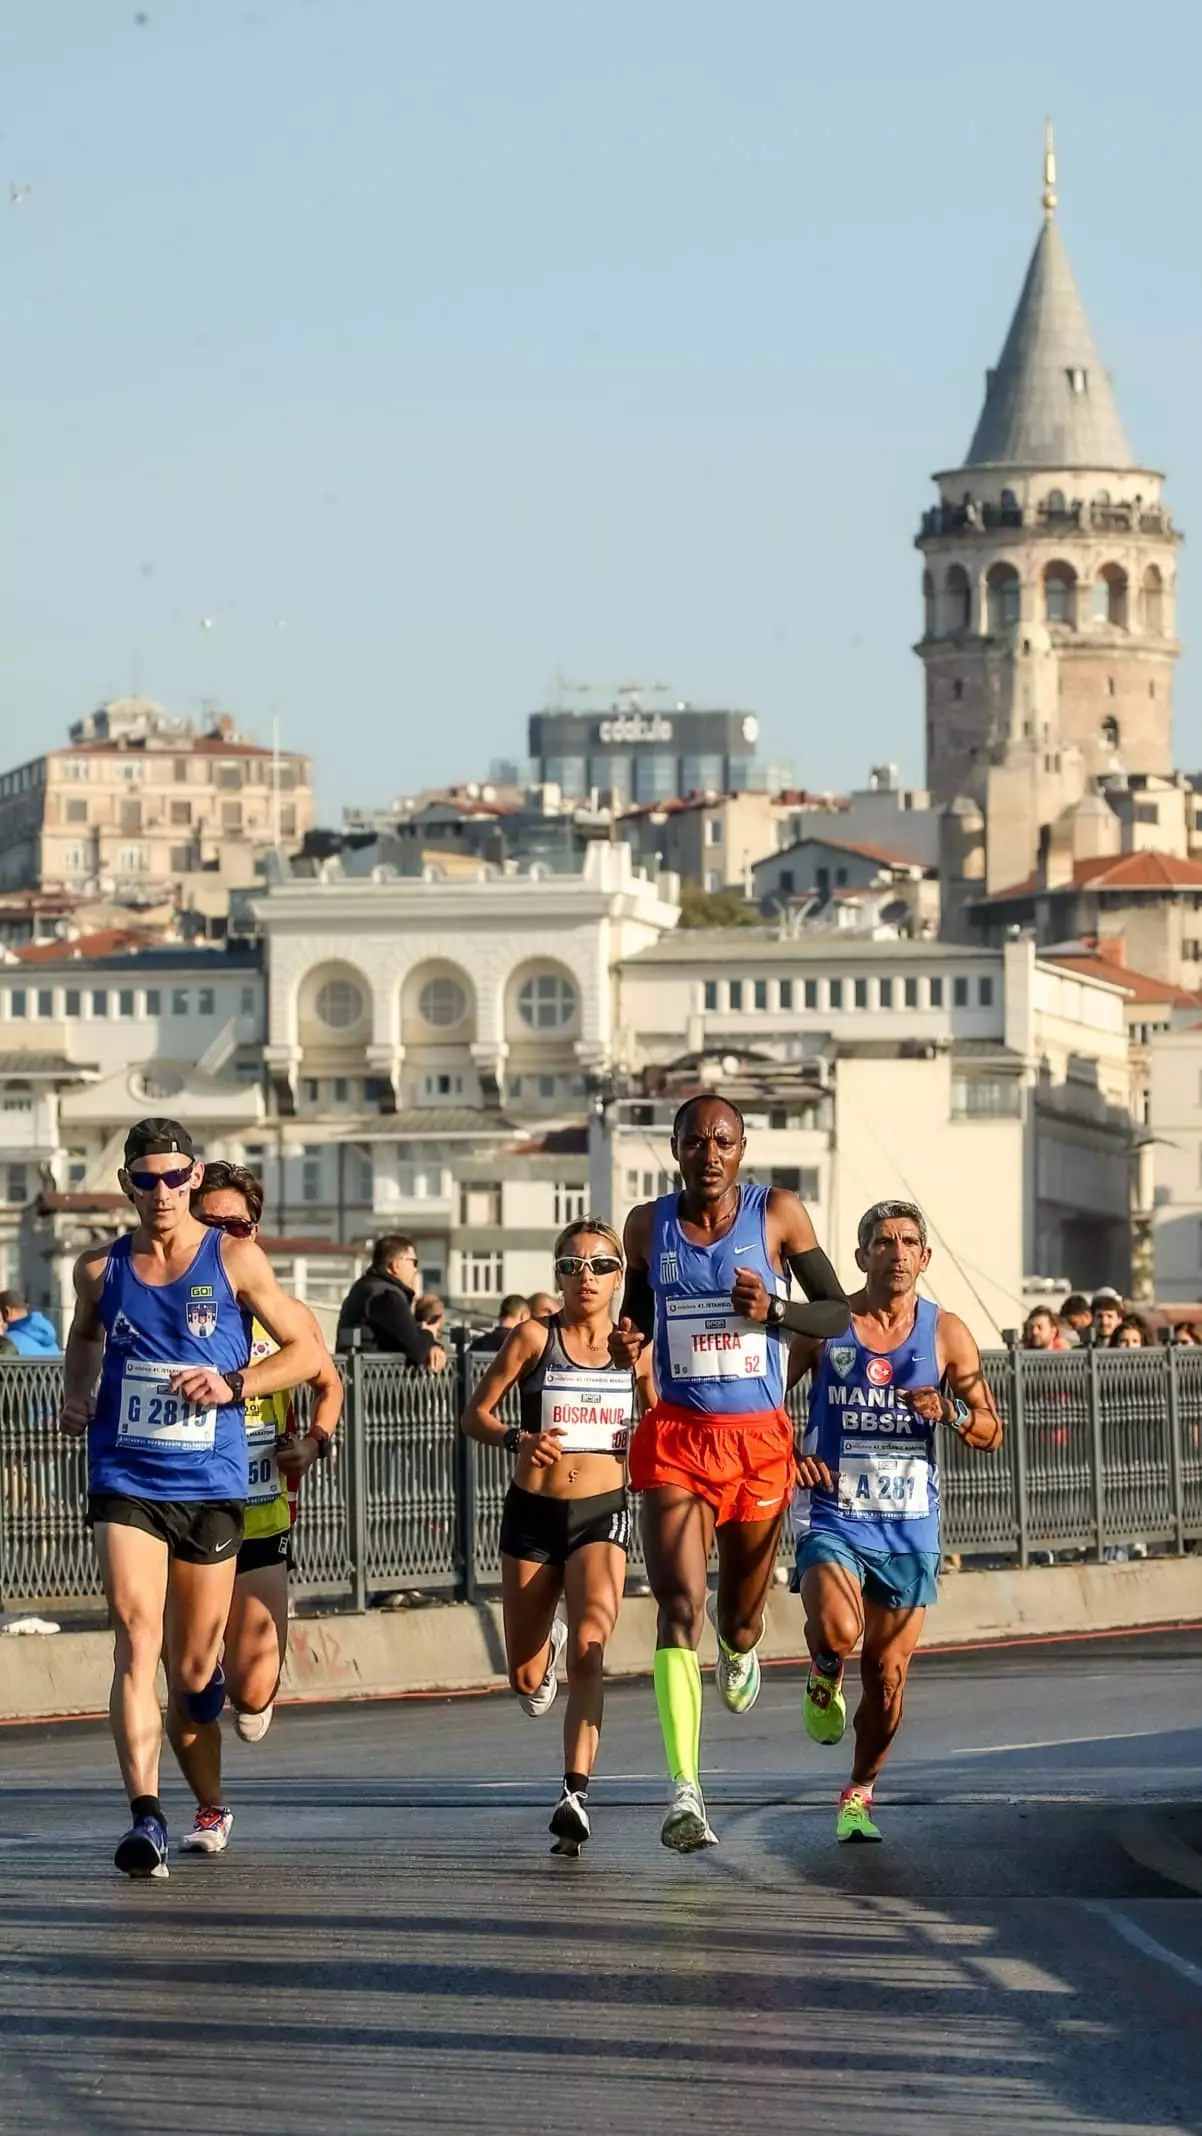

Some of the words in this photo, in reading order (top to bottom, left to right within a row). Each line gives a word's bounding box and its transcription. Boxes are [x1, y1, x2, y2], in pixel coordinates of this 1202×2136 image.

[192, 1287, 212, 1296] GO!
[691, 1332, 741, 1352] TEFERA
[745, 1356, 760, 1373] 52
[128, 1396, 141, 1422] G
[600, 1408, 625, 1425] NUR
[842, 1411, 912, 1434] BBSK
[856, 1475, 870, 1499] A
